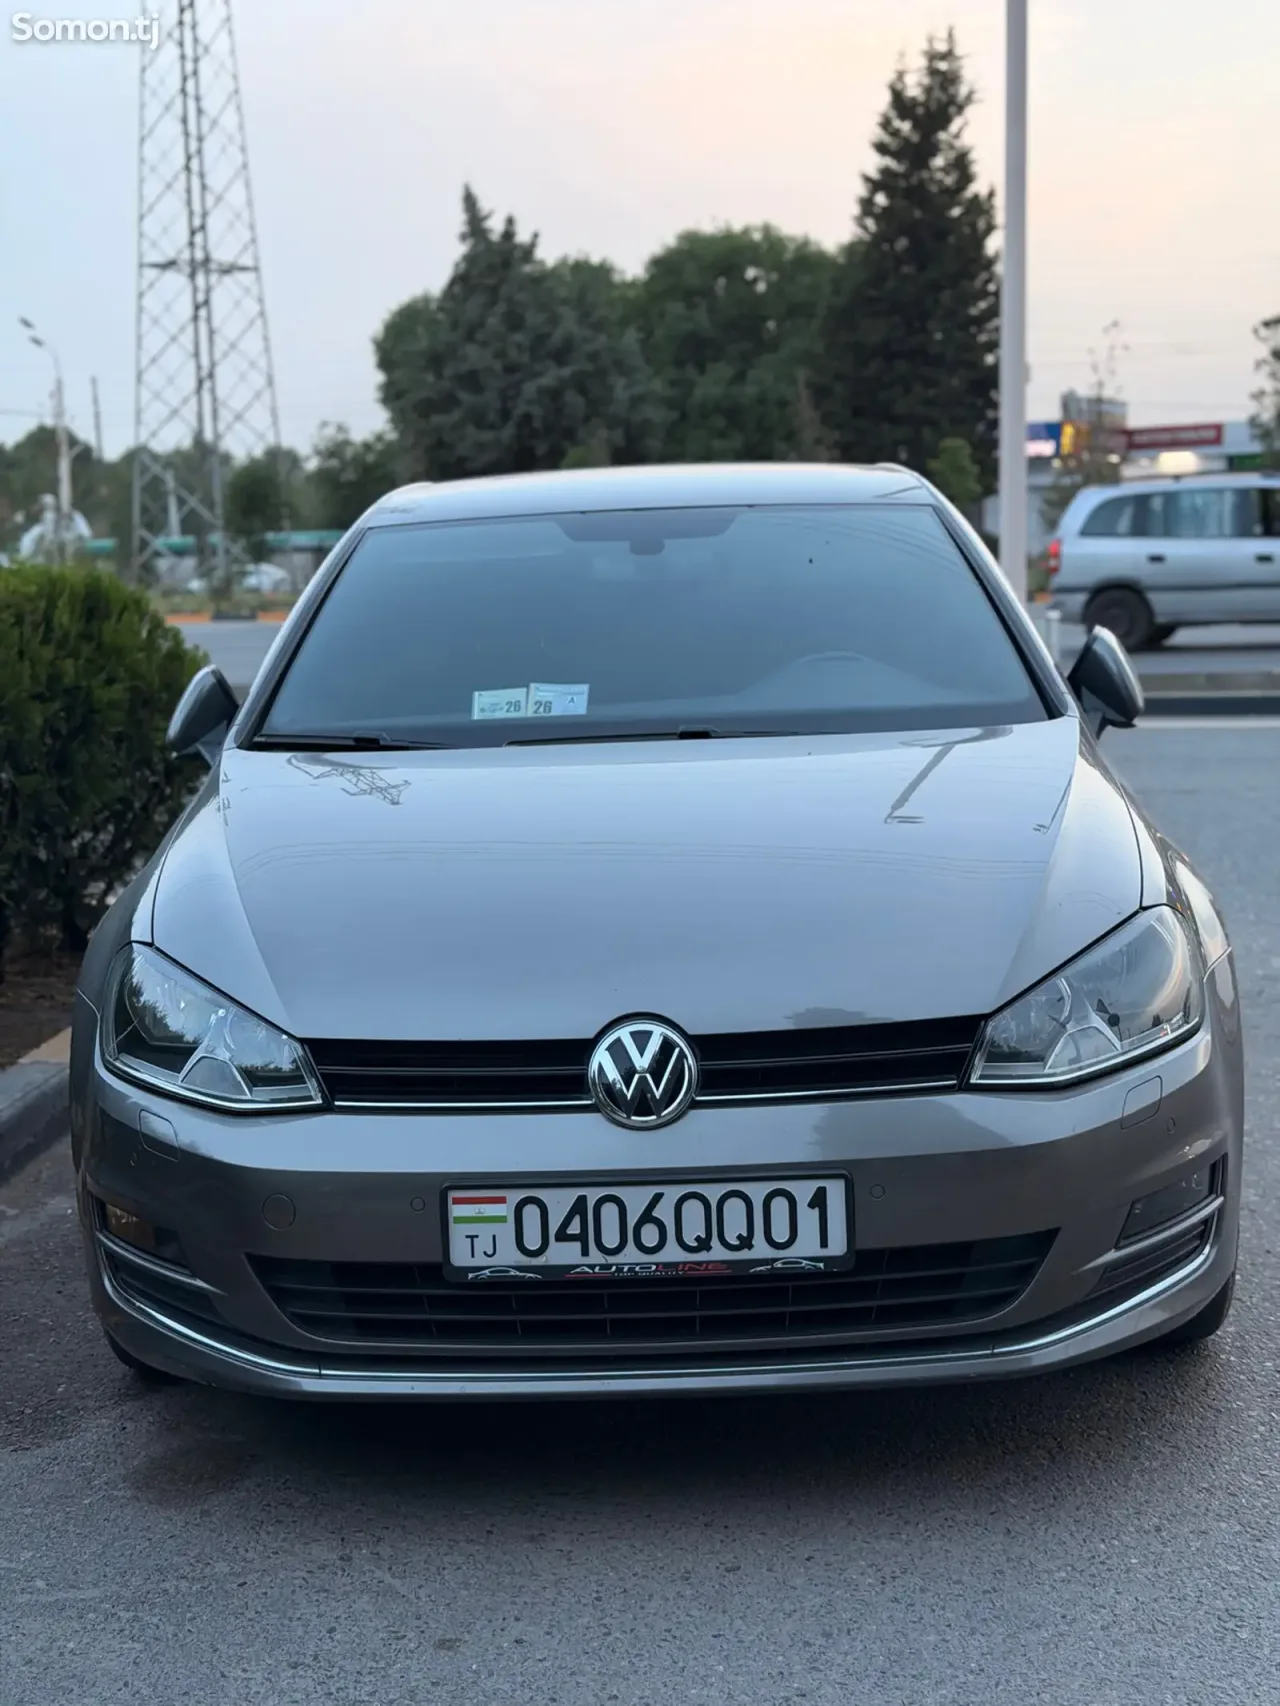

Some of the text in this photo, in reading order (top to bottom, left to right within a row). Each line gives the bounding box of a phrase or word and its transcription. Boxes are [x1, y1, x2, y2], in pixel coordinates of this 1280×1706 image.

[505, 700, 522, 713] 26
[533, 700, 553, 715] 26
[513, 1185, 829, 1258] 0406QQ01
[465, 1234, 497, 1258] TJ
[570, 1261, 728, 1274] AUTOLINE
